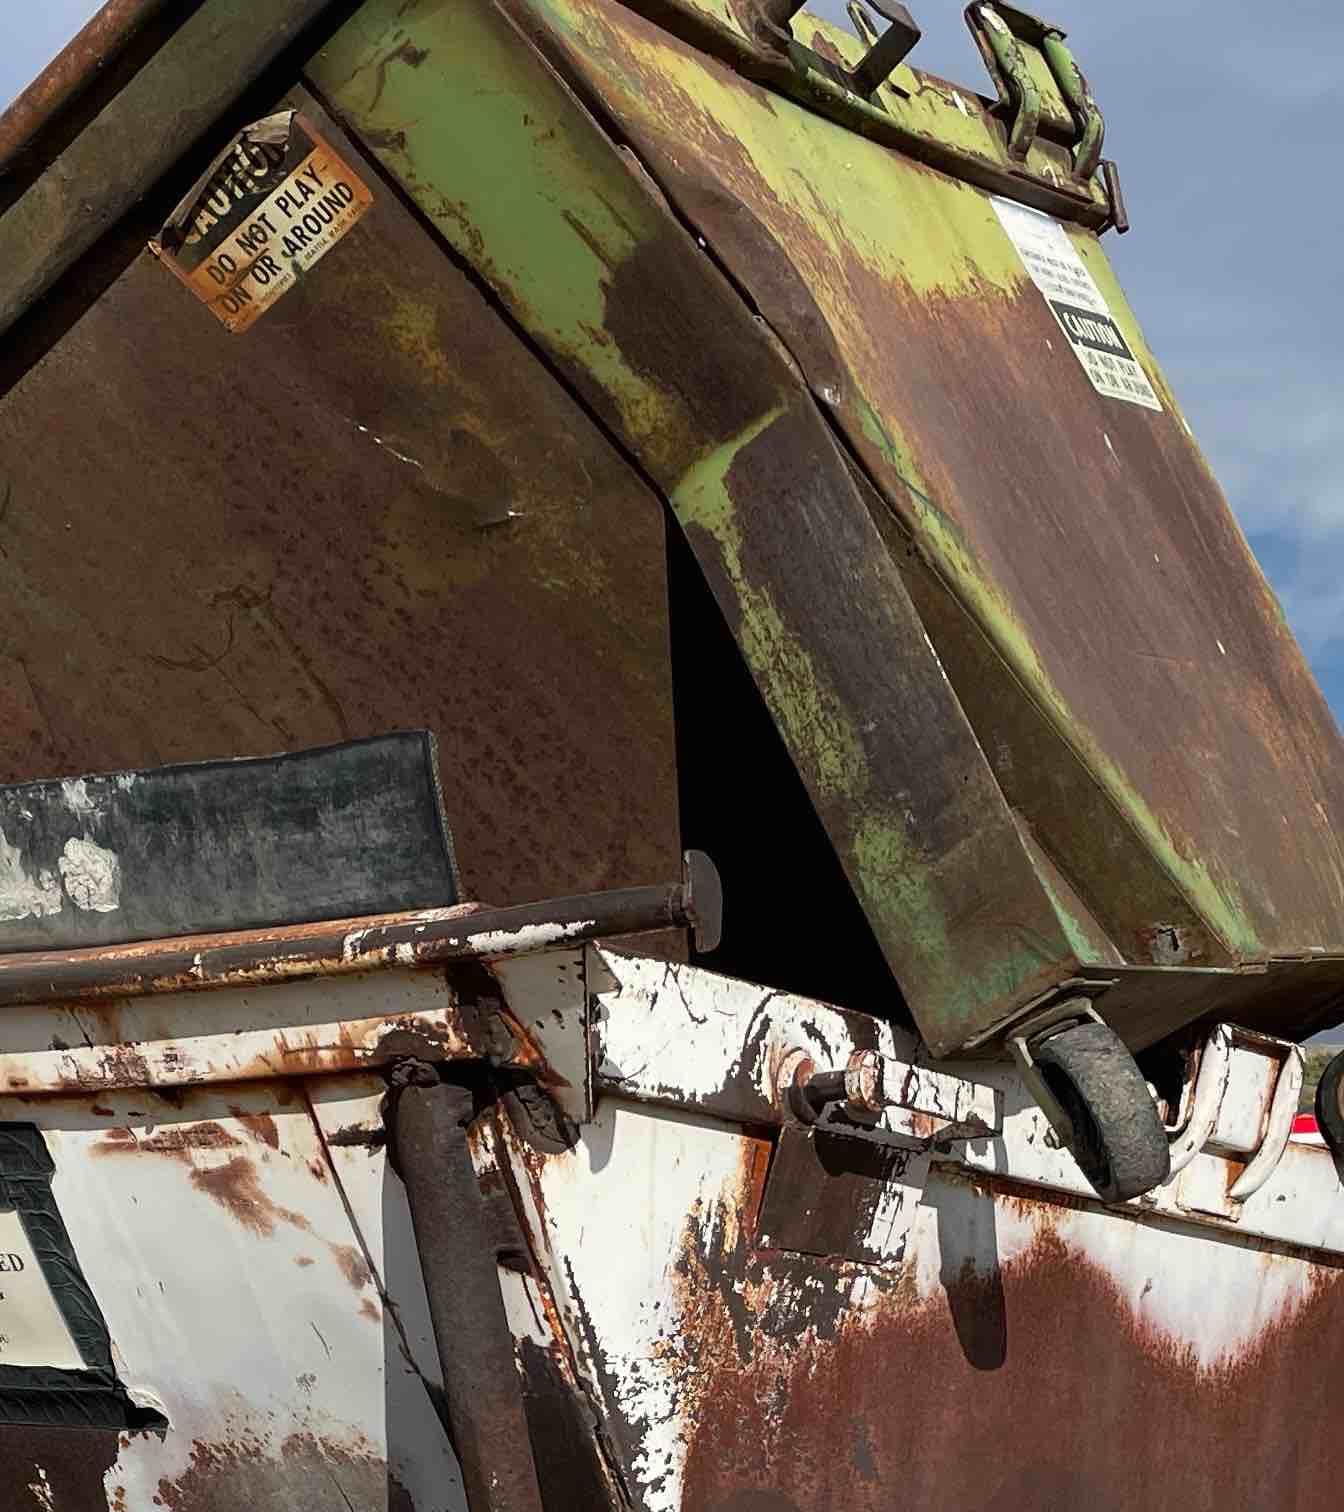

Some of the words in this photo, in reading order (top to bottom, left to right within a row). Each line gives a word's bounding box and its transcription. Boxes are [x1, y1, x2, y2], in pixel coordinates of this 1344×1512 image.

[186, 141, 290, 244] AUTIO
[207, 253, 237, 286] DO
[235, 212, 277, 257] NOT
[275, 162, 324, 218] PLAY
[222, 286, 254, 315] ON
[251, 254, 282, 285] OR
[283, 181, 354, 258] AROUND
[1062, 311, 1124, 350] CAUTION
